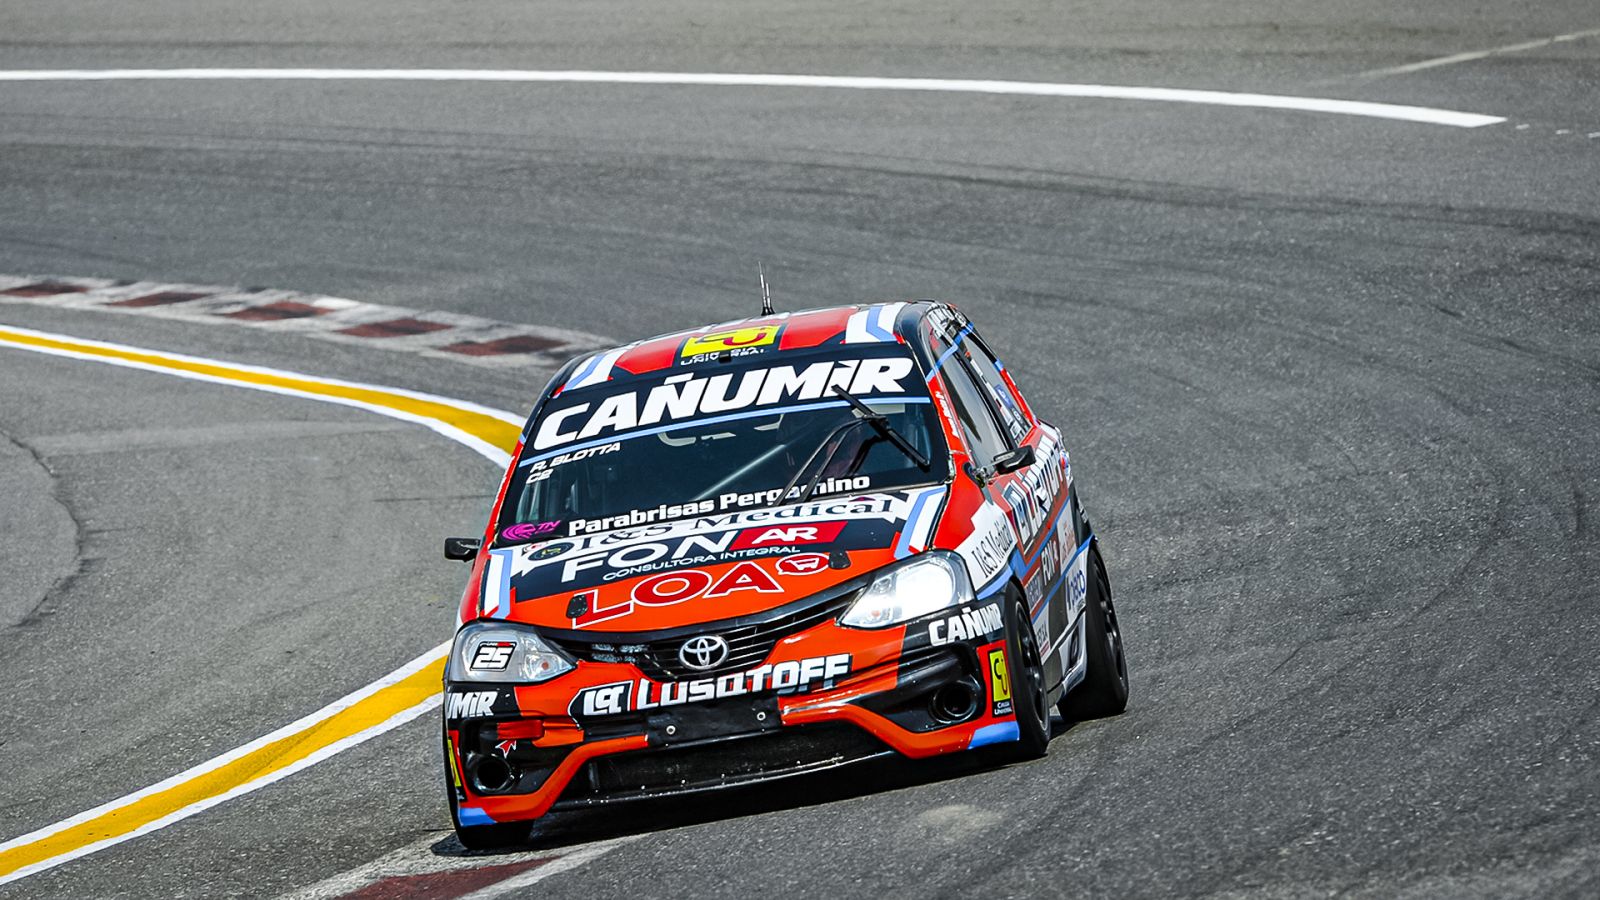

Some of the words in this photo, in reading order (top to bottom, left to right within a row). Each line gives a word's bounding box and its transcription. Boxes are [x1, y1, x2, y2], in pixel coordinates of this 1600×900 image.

[550, 442, 620, 467] BLOTTA
[526, 468, 554, 484] C2
[568, 499, 715, 536] Parabrisas
[690, 498, 896, 530] Medical
[561, 529, 738, 583] FON
[752, 526, 818, 545] AR
[602, 554, 717, 581] CONSULTORA
[719, 545, 800, 561] INTEGRAL
[572, 561, 783, 629] LOA
[472, 646, 514, 669] 25
